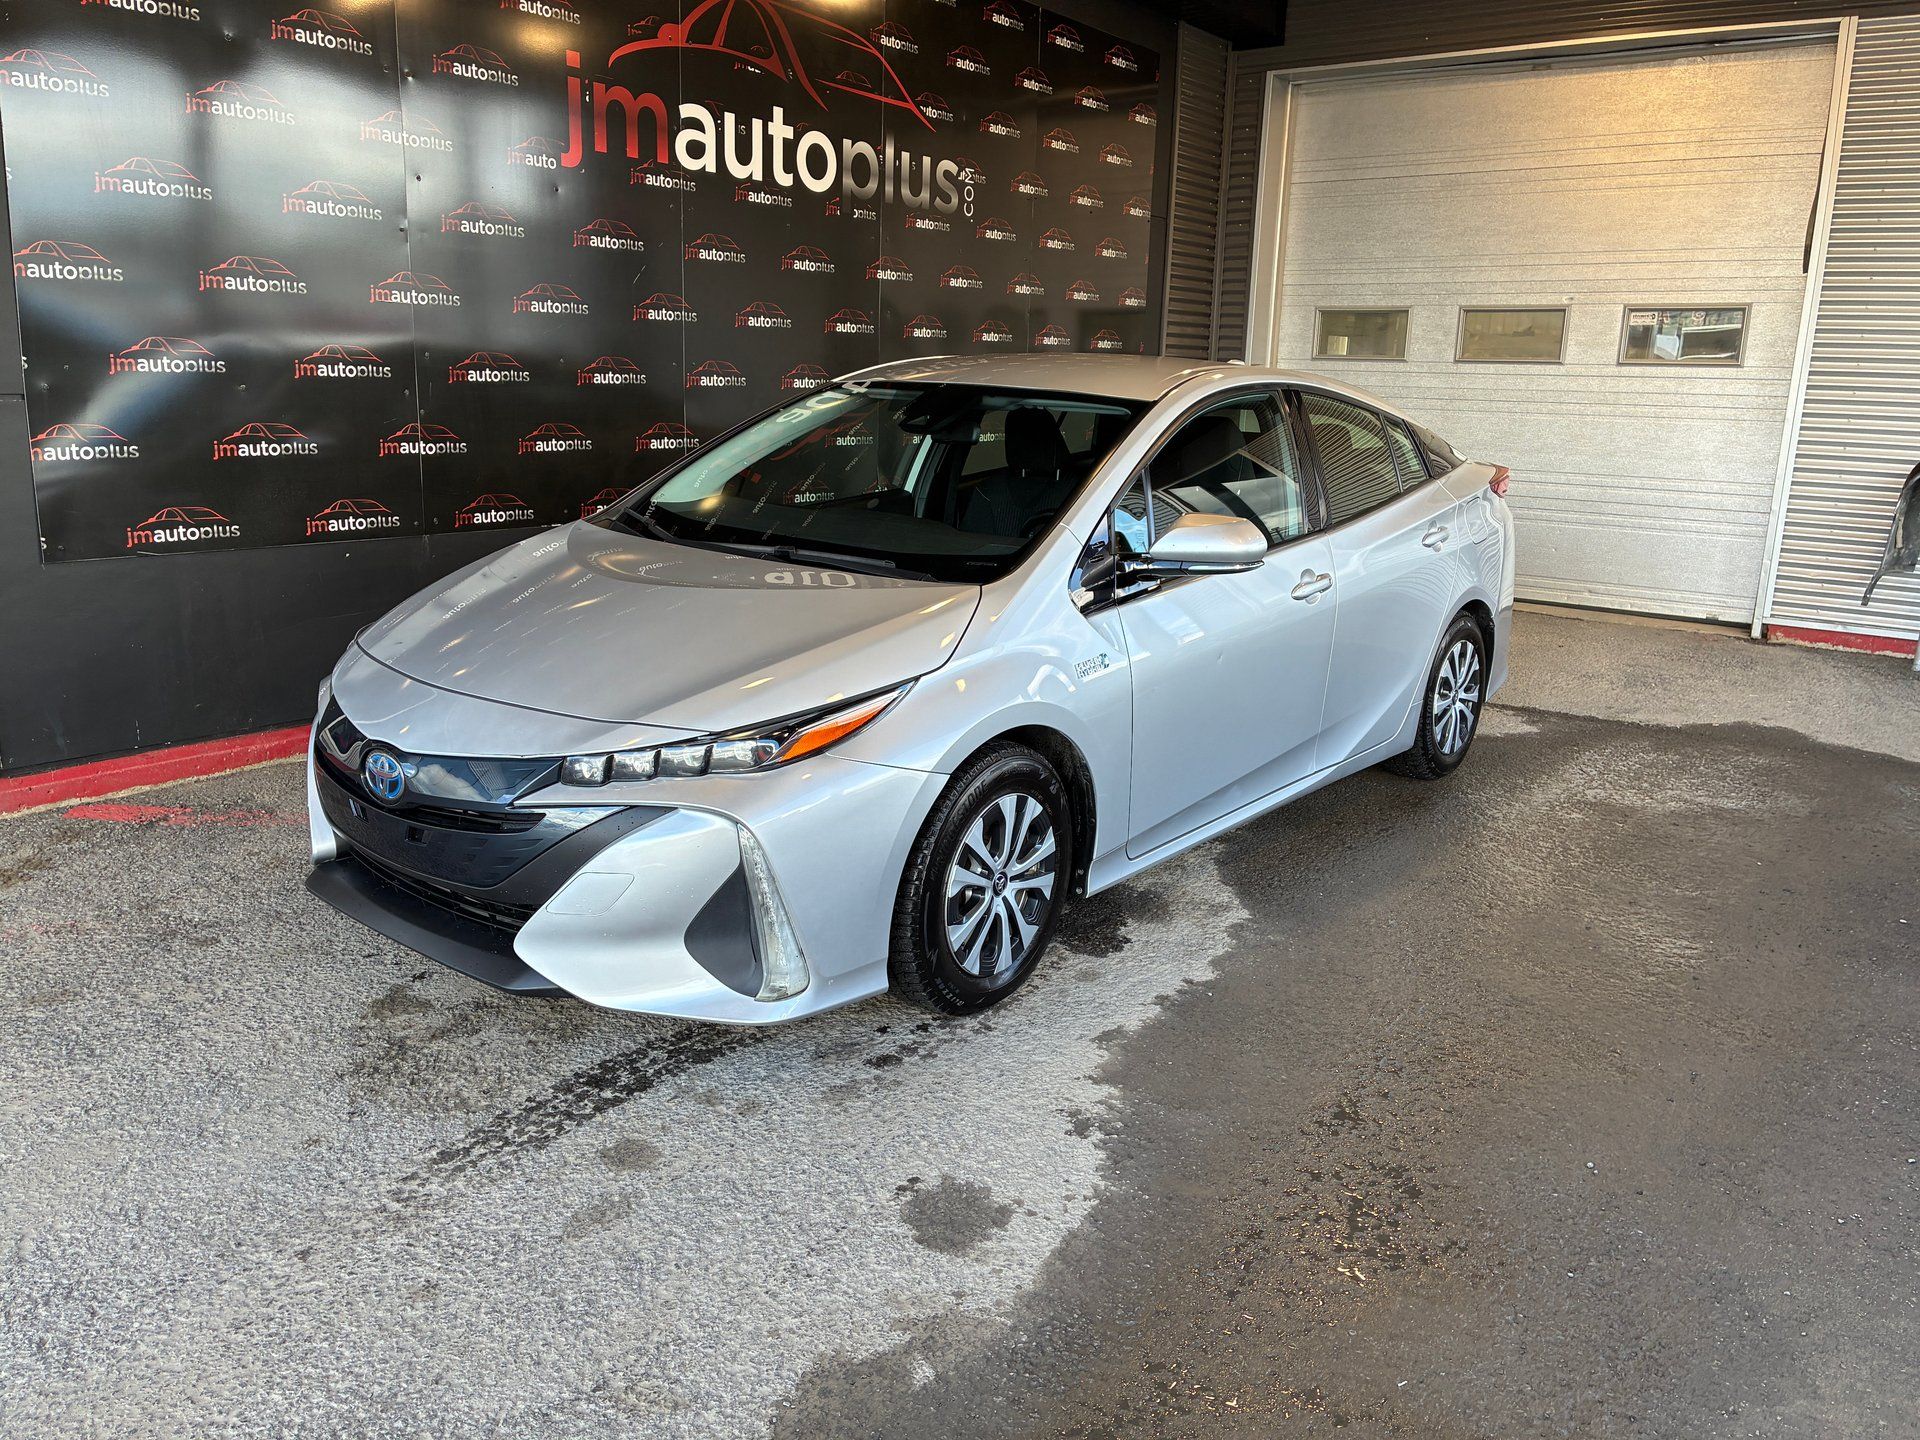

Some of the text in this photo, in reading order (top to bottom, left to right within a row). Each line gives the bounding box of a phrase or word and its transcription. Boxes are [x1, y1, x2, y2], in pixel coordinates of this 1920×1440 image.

[271, 19, 373, 56] jmautoplus
[432, 53, 519, 88] jmautoplus
[185, 91, 296, 126] jmautoplus
[360, 121, 454, 153] jmautoplus
[561, 50, 959, 214] jmautoplus
[94, 172, 213, 201] jmautoplus
[630, 167, 696, 193] jmautoplus
[735, 183, 793, 208] jmautoplus
[962, 167, 976, 223] .com
[282, 193, 383, 222] jmautoplus
[441, 214, 525, 239] jmautoplus
[572, 230, 645, 253] jmautoplus
[685, 242, 746, 265] jmautoplus
[200, 270, 307, 296] jmautoplus
[370, 283, 461, 308] jmautoplus
[512, 297, 589, 315] jmautoplus
[632, 305, 698, 324] jmautoplus
[735, 311, 792, 330] jmautoplus
[108, 352, 227, 376] jmautoplus
[294, 359, 392, 380] jmautoplus
[447, 365, 530, 384] jmautoplus
[577, 369, 647, 386] jmautoplus
[686, 372, 746, 388] jmautoplus
[213, 439, 318, 460] jmautoplus
[378, 439, 468, 458] jmautoplus
[518, 437, 593, 454] jmautoplus
[635, 434, 700, 452] jmautoplus
[305, 513, 400, 536] jmautoplus
[454, 506, 535, 527] jmautoplus
[126, 521, 241, 548] jmautoplus
